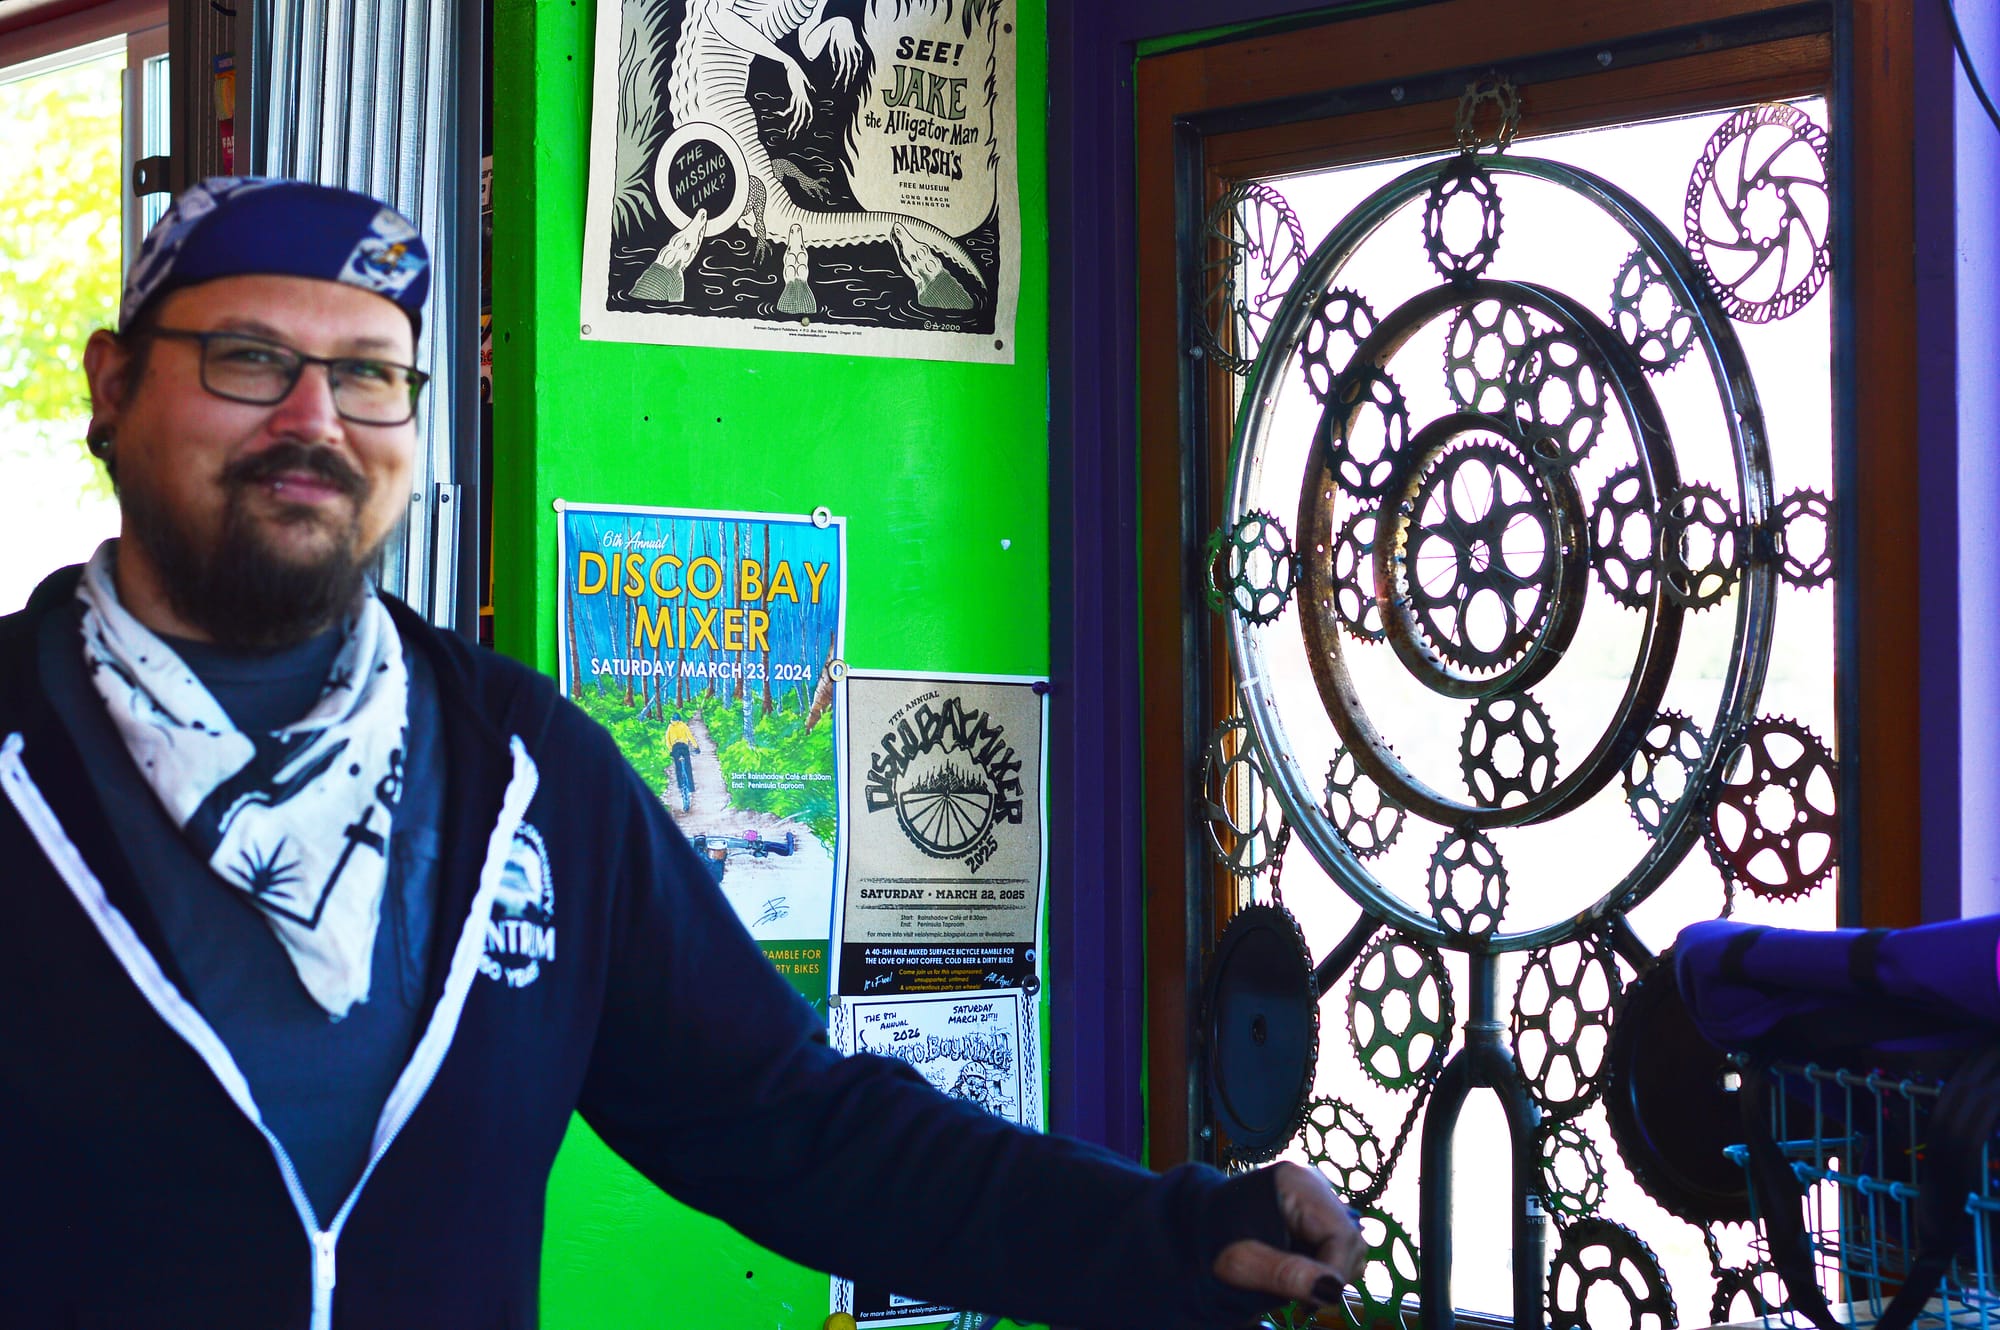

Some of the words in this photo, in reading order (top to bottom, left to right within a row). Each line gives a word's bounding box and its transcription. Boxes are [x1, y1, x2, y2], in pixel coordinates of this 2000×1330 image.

[896, 36, 964, 66] SEE!
[880, 65, 967, 120] JAKE
[864, 111, 882, 128] the
[884, 110, 949, 142] Alligator
[949, 123, 979, 145] Man
[676, 145, 703, 170] THE
[890, 145, 963, 181] MARSH'S
[675, 154, 726, 200] MISSING
[692, 173, 726, 208] LINK?
[919, 184, 950, 192] MUSEUM
[900, 200, 950, 208] WASHINGTON
[603, 530, 623, 547] 6th
[624, 531, 669, 550] Annual
[577, 551, 723, 600] DISCO
[740, 559, 830, 604] BAY
[633, 606, 770, 652] MIXER
[591, 658, 676, 677] SATURDAY
[680, 661, 742, 678] MARCH
[746, 662, 770, 681] 23,
[774, 664, 812, 681] 2024
[888, 709, 904, 726] 7TH
[905, 690, 940, 711] ANNUAL
[914, 696, 979, 754] BAY
[969, 712, 1024, 825] MIXER
[732, 772, 746, 780] Start:
[748, 772, 784, 780] Rainshadow
[777, 782, 804, 790] Taproom
[965, 835, 998, 874] 2025
[860, 889, 924, 899] SATURDAY
[936, 889, 978, 900] MARCH
[981, 890, 996, 900] 22,
[1000, 890, 1025, 900] 2025
[485, 919, 555, 961] NTRUM
[802, 949, 821, 960] FOR
[920, 957, 943, 965] COFFEE,
[794, 964, 819, 974] BIKES
[864, 1014, 881, 1023] THE
[884, 1012, 896, 1020] 8TH
[953, 1003, 993, 1014] SATURDAY
[880, 1019, 909, 1030] ANNUAL
[948, 1015, 977, 1024] MARCH
[893, 1028, 920, 1041] 2026
